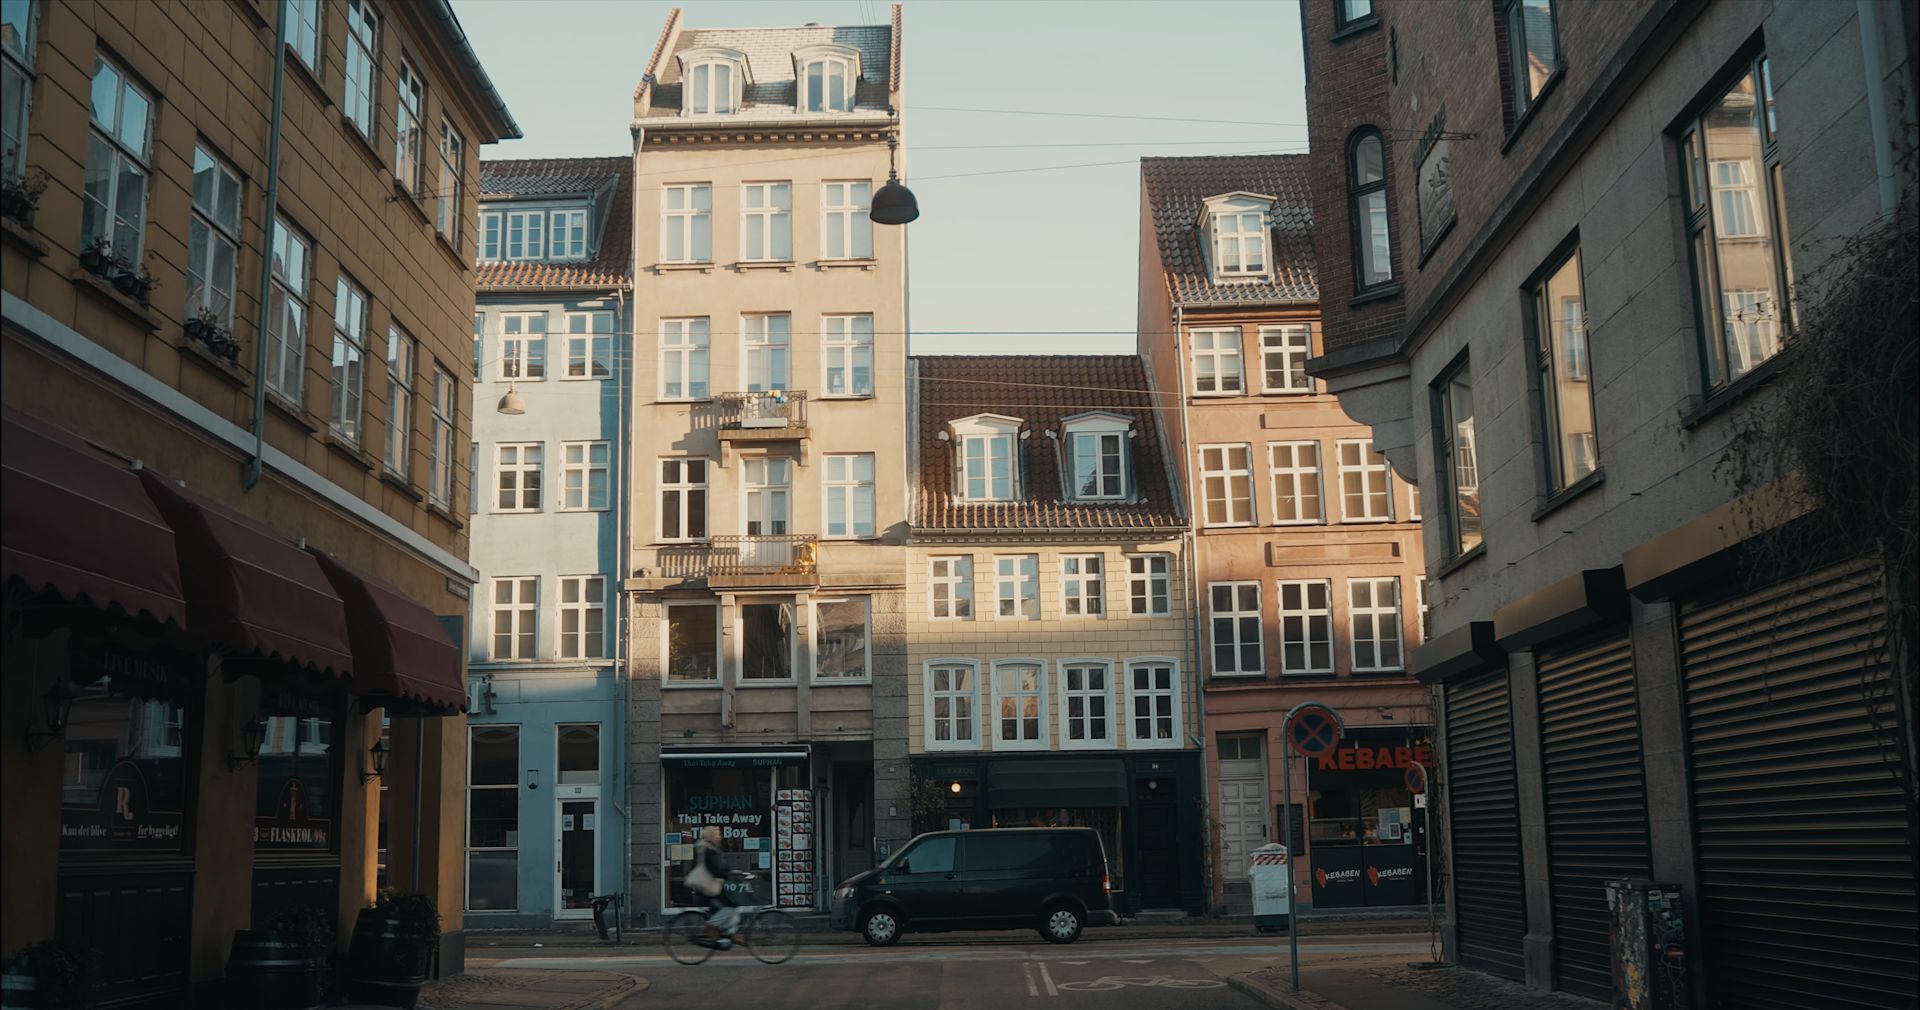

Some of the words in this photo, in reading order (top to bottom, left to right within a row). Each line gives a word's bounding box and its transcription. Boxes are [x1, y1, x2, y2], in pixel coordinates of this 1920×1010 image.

[688, 795, 753, 811] SUPHAN
[678, 813, 702, 824] Thai
[704, 813, 730, 824] Take
[732, 813, 762, 826] Away
[78, 824, 90, 837] det
[724, 826, 749, 838] Box
